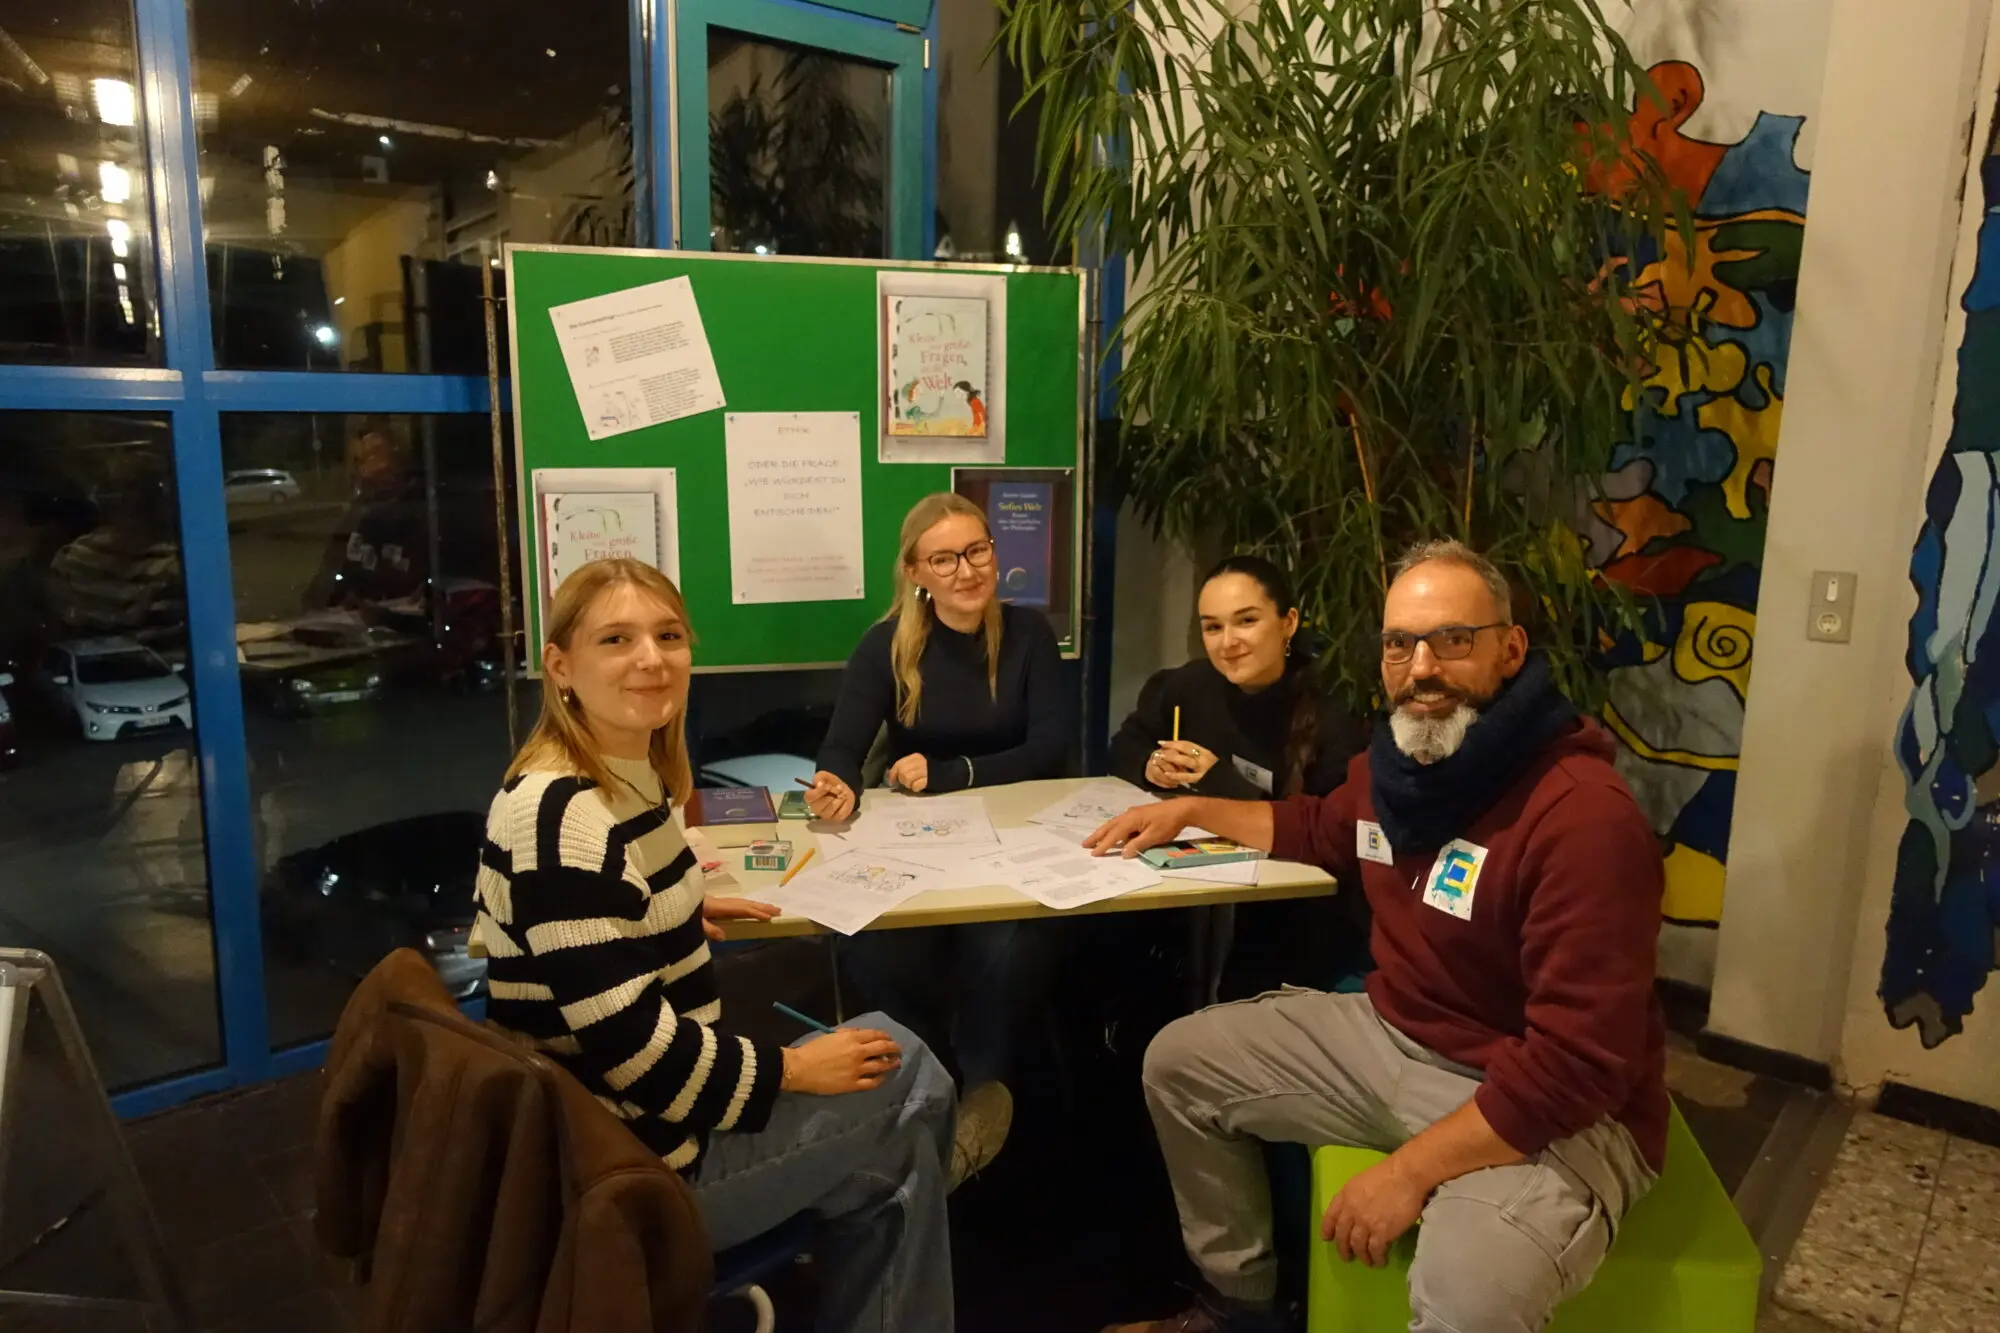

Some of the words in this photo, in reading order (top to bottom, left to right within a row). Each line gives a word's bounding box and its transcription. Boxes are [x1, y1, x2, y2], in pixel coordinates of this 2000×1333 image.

[922, 371, 953, 390] Welt
[781, 460, 799, 469] DIE
[801, 459, 840, 469] FRAGE
[783, 491, 810, 501] DICH
